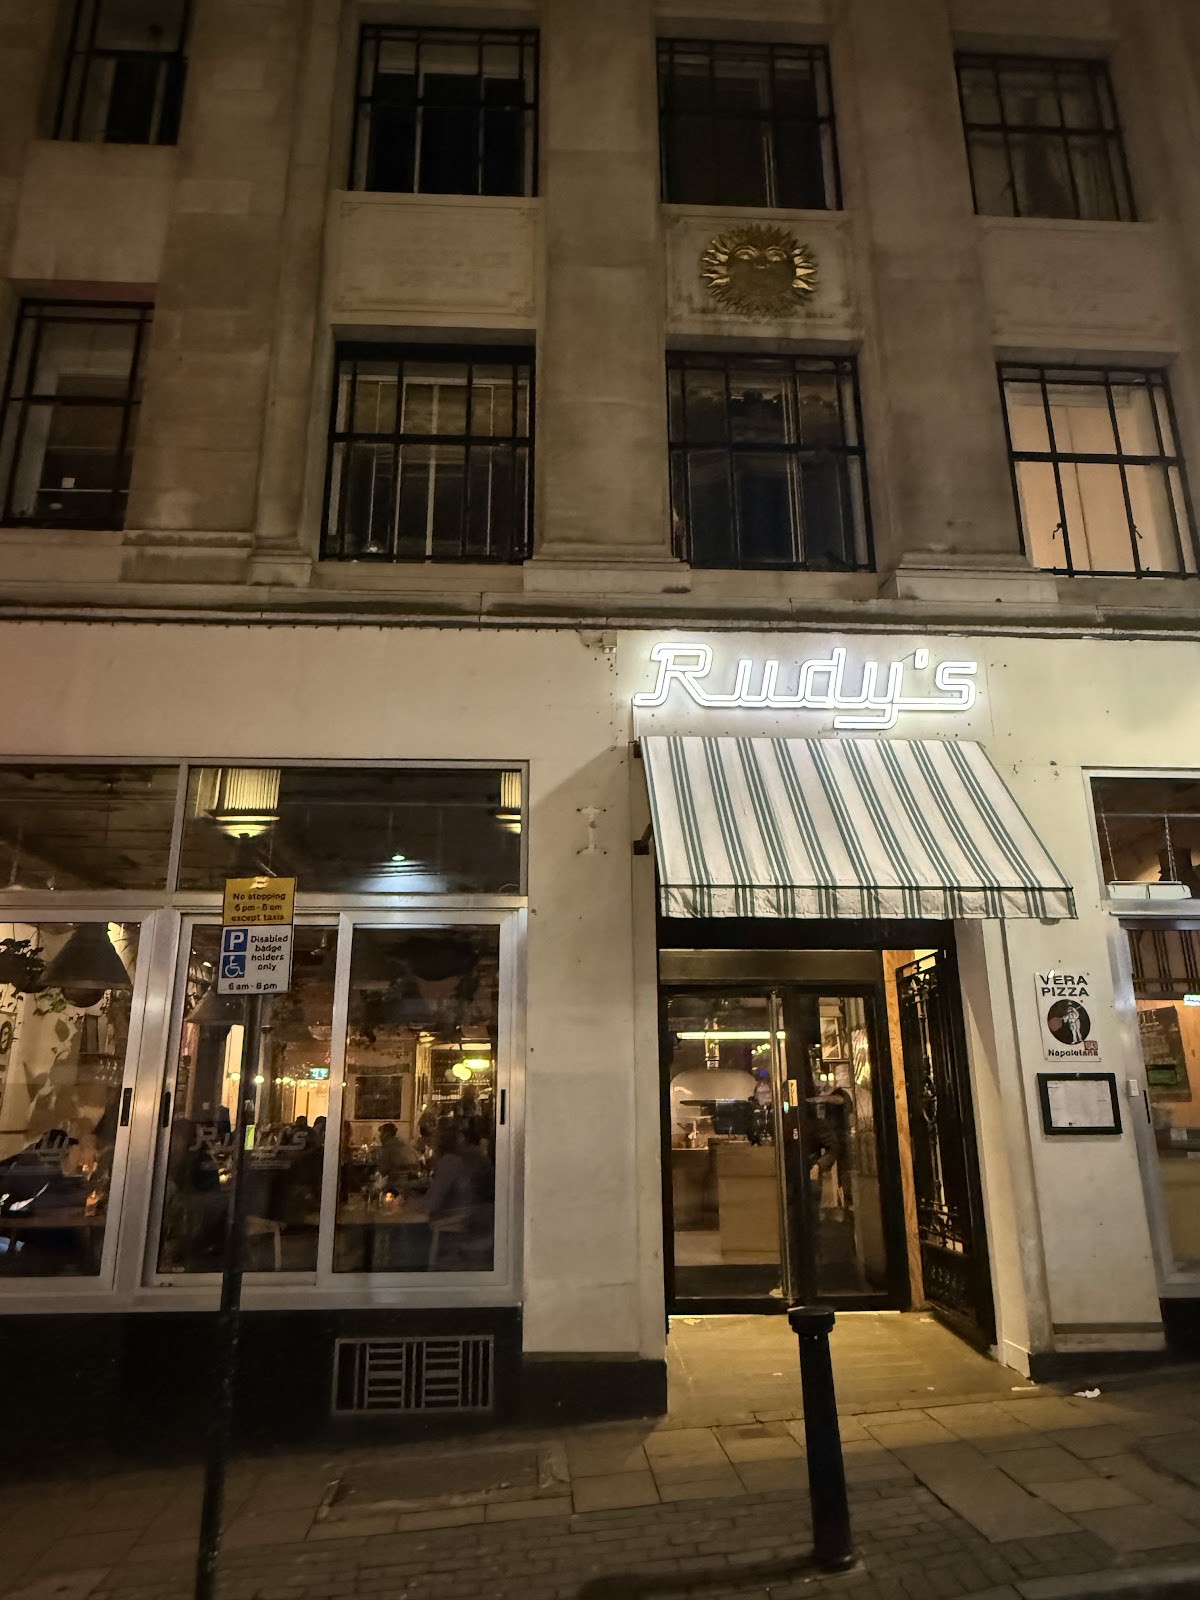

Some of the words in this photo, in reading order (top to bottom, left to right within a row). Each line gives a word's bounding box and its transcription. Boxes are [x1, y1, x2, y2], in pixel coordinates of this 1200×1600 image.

[633, 642, 978, 730] Rudy's
[233, 893, 245, 901] No
[248, 892, 286, 903] stopping
[230, 932, 244, 951] P
[250, 935, 289, 943] Disabled
[254, 944, 282, 953] badge
[251, 953, 284, 962] holders
[257, 962, 277, 972] only
[1039, 975, 1088, 985] VERA
[263, 983, 278, 991] pm
[1041, 987, 1089, 996] PIZZA
